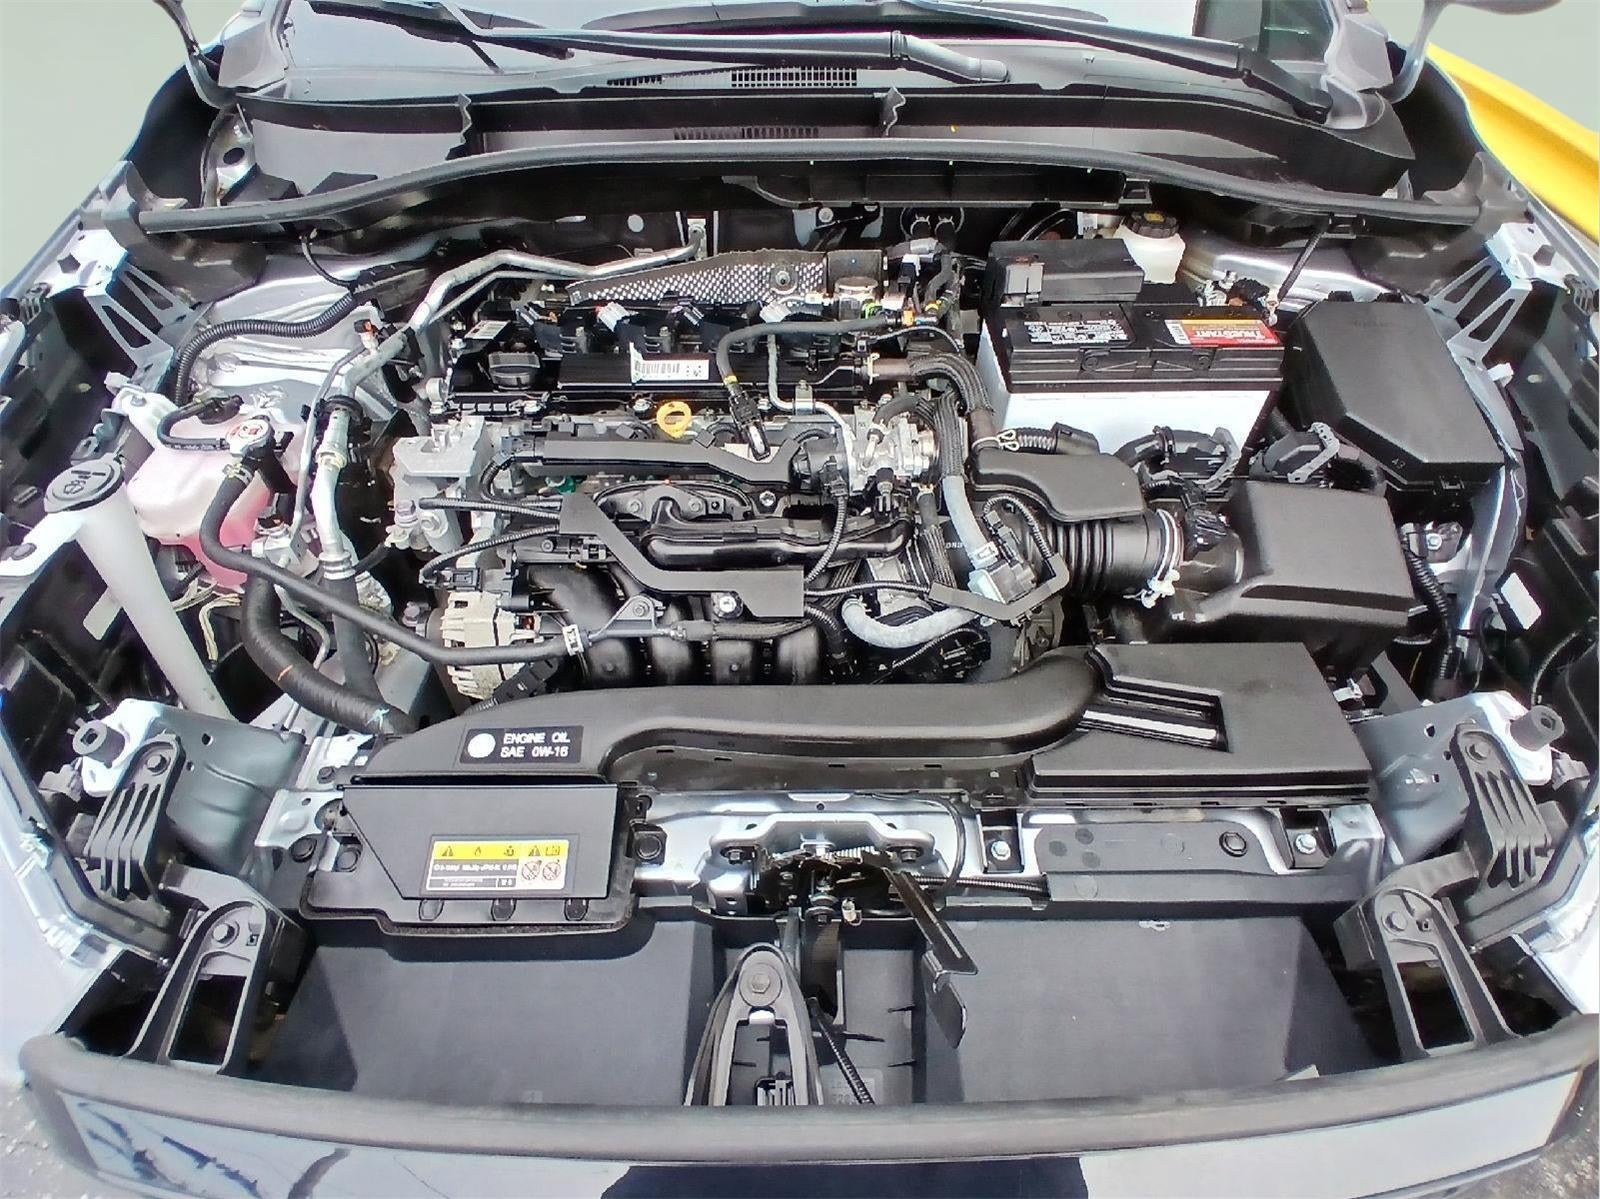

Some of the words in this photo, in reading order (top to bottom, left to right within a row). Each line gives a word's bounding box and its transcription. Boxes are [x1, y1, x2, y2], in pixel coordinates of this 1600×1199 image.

[503, 732, 546, 744] ENGINE
[551, 731, 571, 743] OIL
[500, 746, 525, 758] SAE
